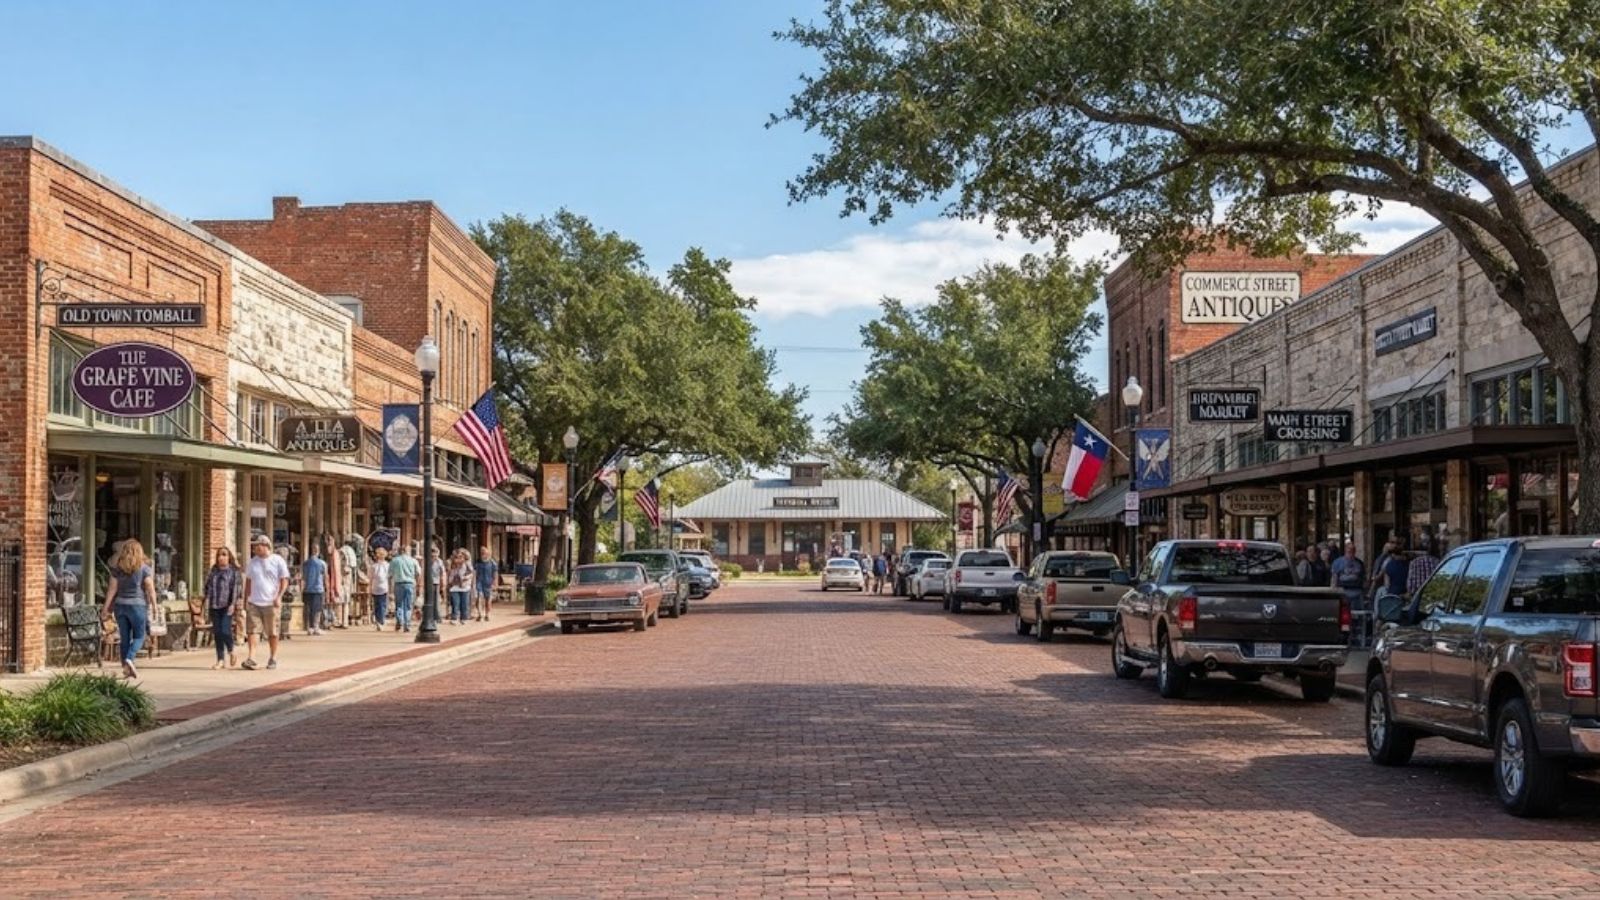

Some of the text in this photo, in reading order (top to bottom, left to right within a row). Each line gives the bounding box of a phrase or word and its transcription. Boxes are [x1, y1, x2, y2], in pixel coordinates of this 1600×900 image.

[1253, 277, 1297, 291] STREET
[63, 308, 195, 323] OLD TOWN TOMBALL
[141, 367, 184, 387] VINE
[110, 388, 156, 409] CAFE
[285, 438, 356, 453] ANTIQUES
